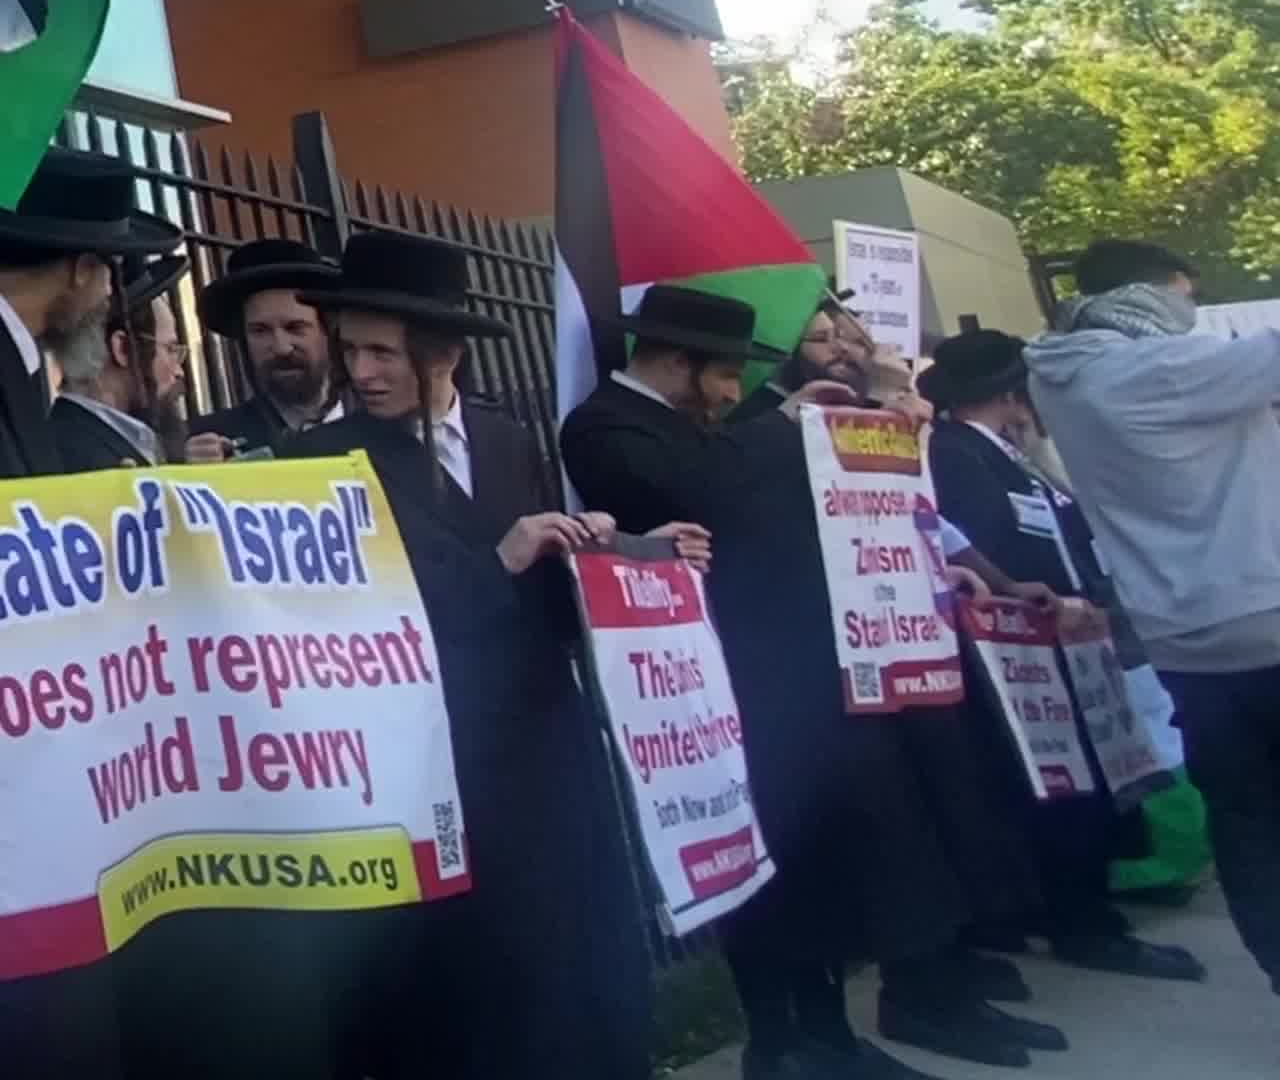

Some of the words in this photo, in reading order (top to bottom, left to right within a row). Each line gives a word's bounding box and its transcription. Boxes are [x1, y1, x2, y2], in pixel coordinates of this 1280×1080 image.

[116, 481, 165, 593] of
[176, 484, 371, 586] "Israel"
[99, 624, 175, 715] not
[186, 615, 433, 709] represent
[87, 716, 200, 824] world
[217, 715, 374, 806] Jewry
[121, 853, 399, 917] www.NKUSA.org
